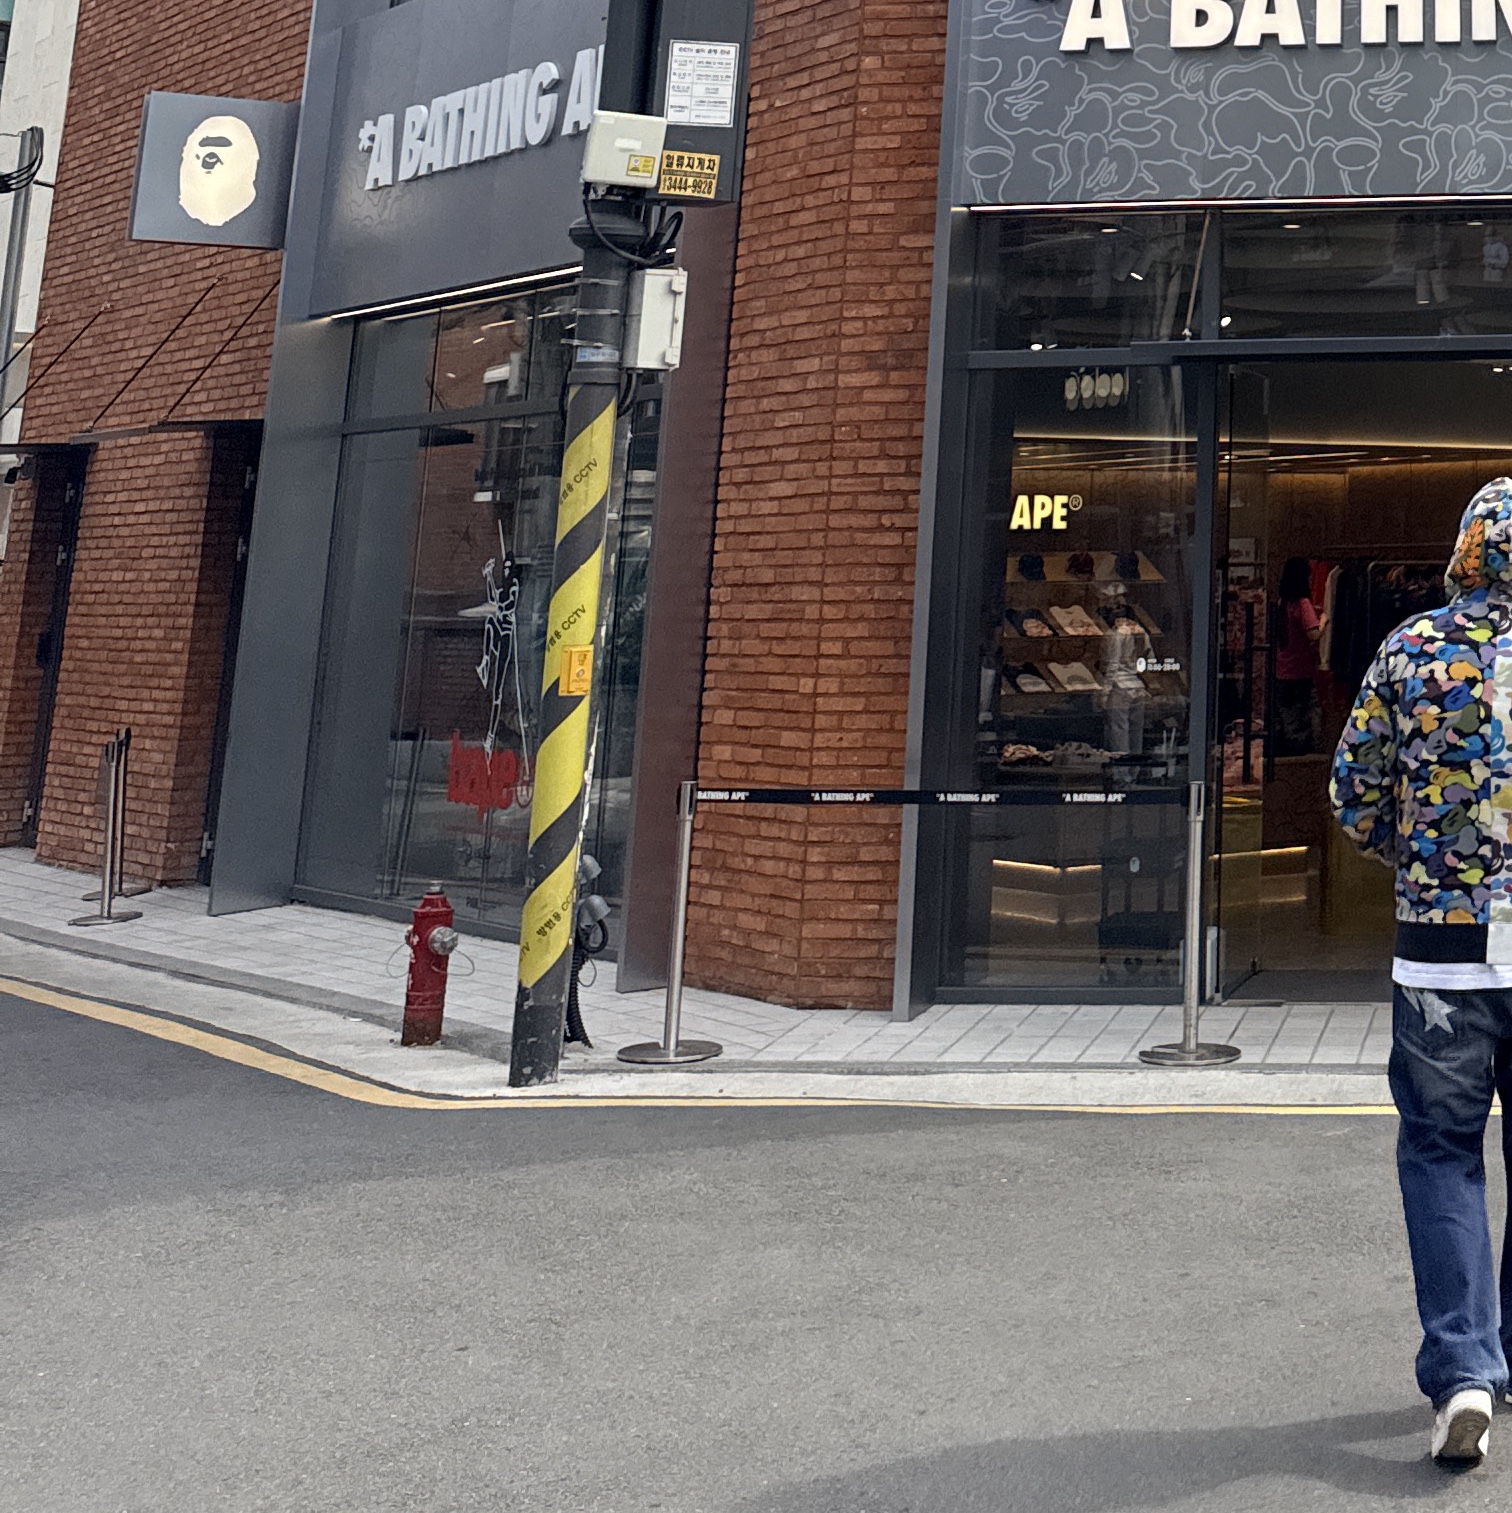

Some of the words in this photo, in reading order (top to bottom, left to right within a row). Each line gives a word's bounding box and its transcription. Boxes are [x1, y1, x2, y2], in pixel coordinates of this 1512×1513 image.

[398, 61, 561, 182] BATHING
[561, 44, 606, 137] A
[573, 457, 598, 485] CCTV
[561, 603, 586, 631] CCTV
